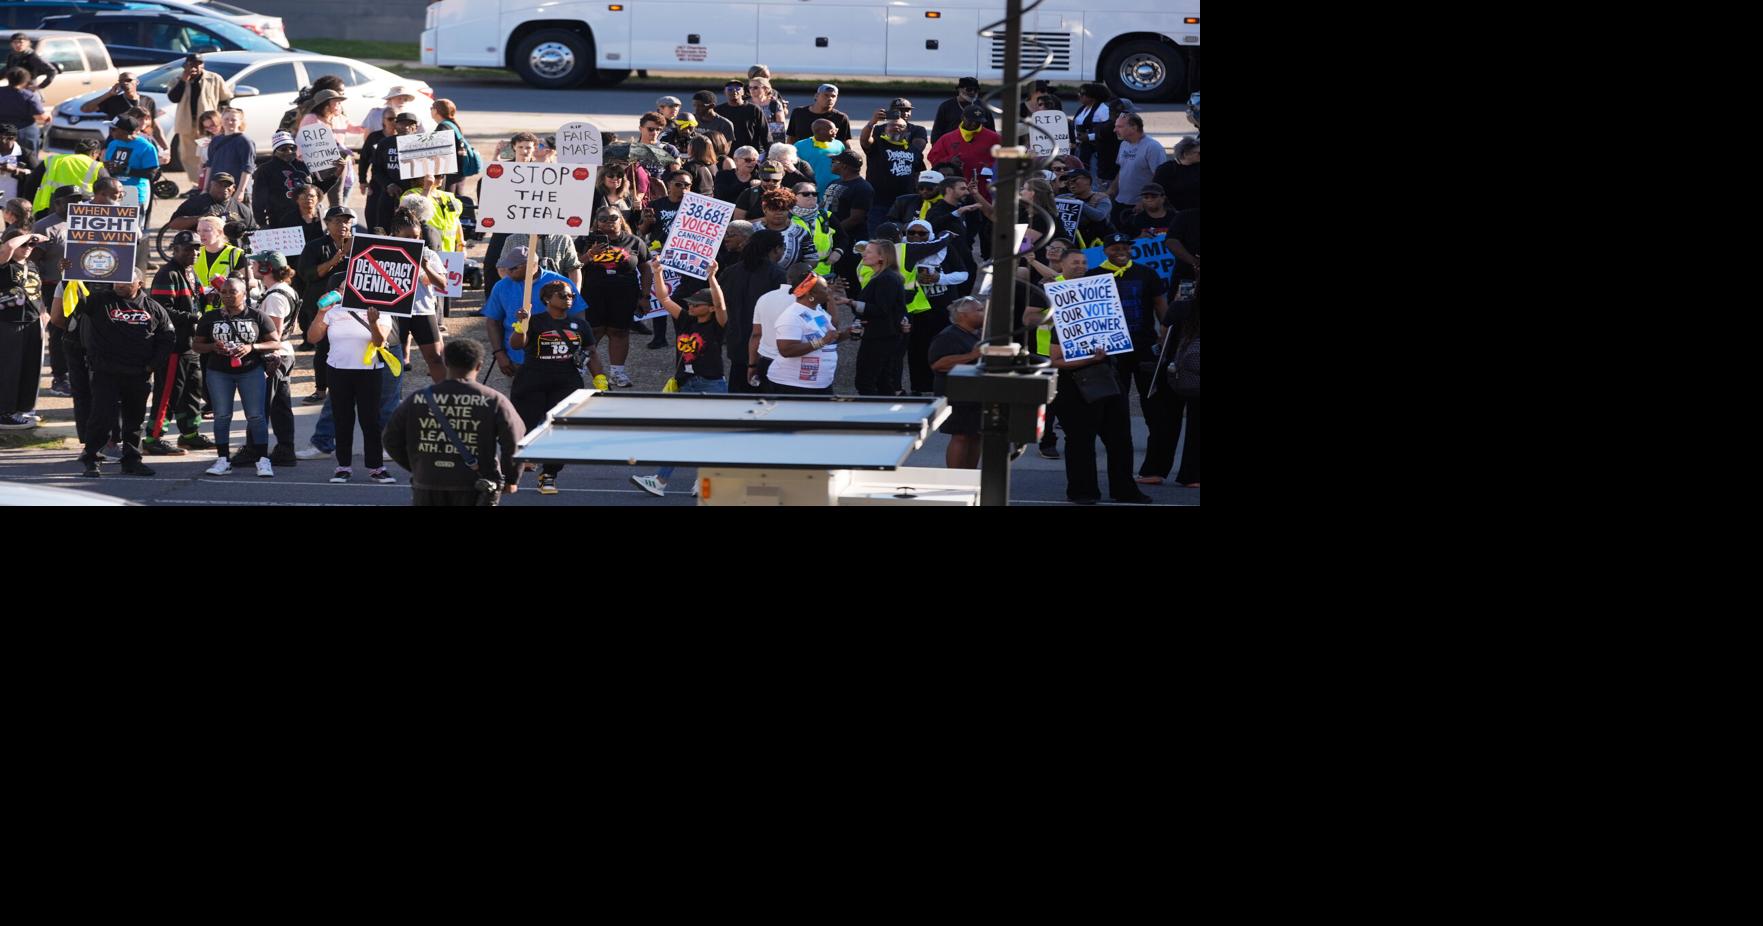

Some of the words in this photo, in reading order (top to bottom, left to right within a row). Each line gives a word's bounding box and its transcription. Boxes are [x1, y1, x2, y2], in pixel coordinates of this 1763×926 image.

[1034, 115, 1062, 124] RIP
[303, 128, 327, 141] RIP
[563, 130, 597, 142] FAIR
[305, 148, 339, 159] VOTING
[562, 144, 599, 156] MAPS
[510, 165, 570, 185] STOP
[515, 190, 557, 202] THE
[73, 206, 110, 216] WHEN
[117, 207, 136, 217] WE
[507, 204, 565, 219] STEAL
[71, 217, 135, 231] FIGHT
[681, 215, 720, 238] VOICES
[71, 231, 95, 241] WE
[102, 231, 133, 242] WIN
[677, 230, 706, 243] CANNOT
[705, 236, 715, 247] BE
[670, 236, 714, 258] SILENCED
[355, 258, 413, 279] DEMOCRACY
[353, 273, 411, 295] DENIERS
[1054, 289, 1079, 308] OUR
[1079, 285, 1116, 301] VOICE.
[1061, 306, 1084, 323] OUR
[1084, 302, 1117, 317] VOTE.
[1062, 323, 1084, 340] OUR
[1084, 317, 1125, 333] POWER.
[413, 393, 449, 404] NW
[452, 394, 489, 407] YORK
[418, 418, 481, 431] VASITY
[420, 430, 479, 444] LEAUE
